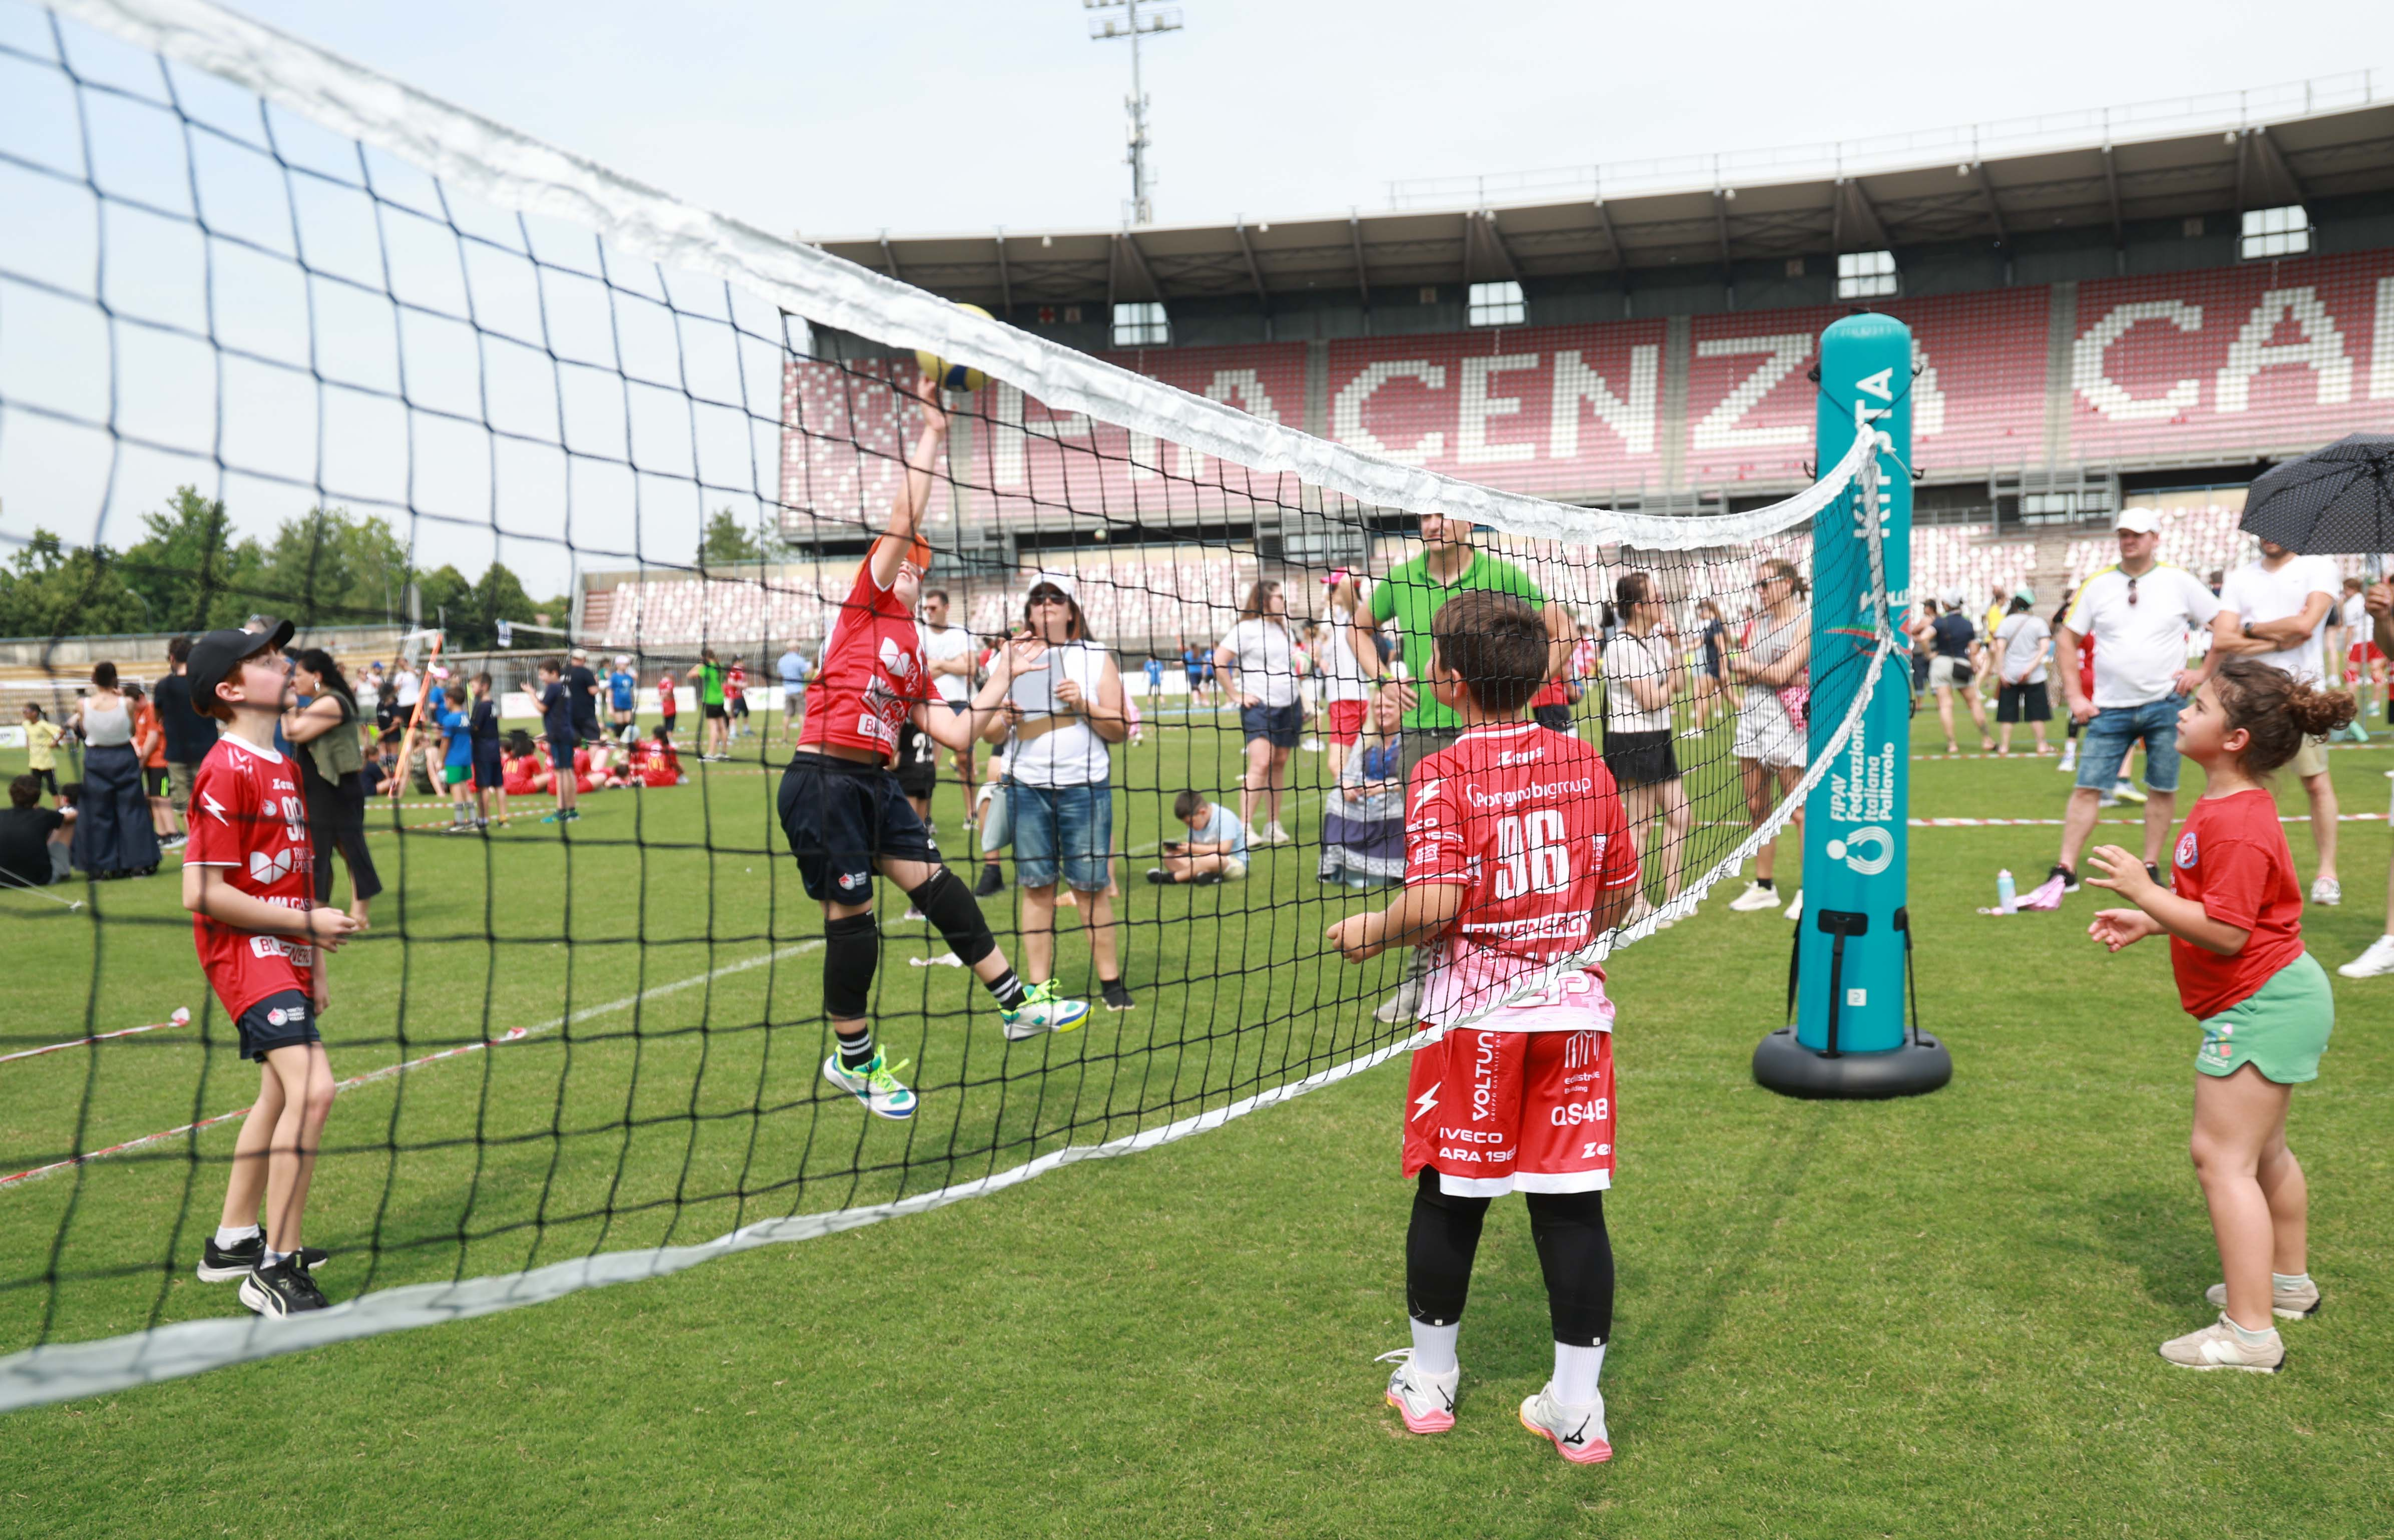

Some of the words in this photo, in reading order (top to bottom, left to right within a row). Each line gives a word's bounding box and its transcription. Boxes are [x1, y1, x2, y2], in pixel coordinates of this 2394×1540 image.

[995, 333, 1944, 485] PIACENZ
[1496, 746, 1545, 766] Zeus
[1846, 719, 1865, 823] Federazione
[1863, 755, 1880, 822] Italiana
[1878, 742, 1895, 821] Pallavolo
[1830, 773, 1846, 822] FIPAV
[1495, 809, 1569, 900] 96
[1472, 1031, 1494, 1121] VOLTUN
[1551, 1097, 1609, 1126] QS4B
[1439, 1126, 1503, 1144] IVECO
